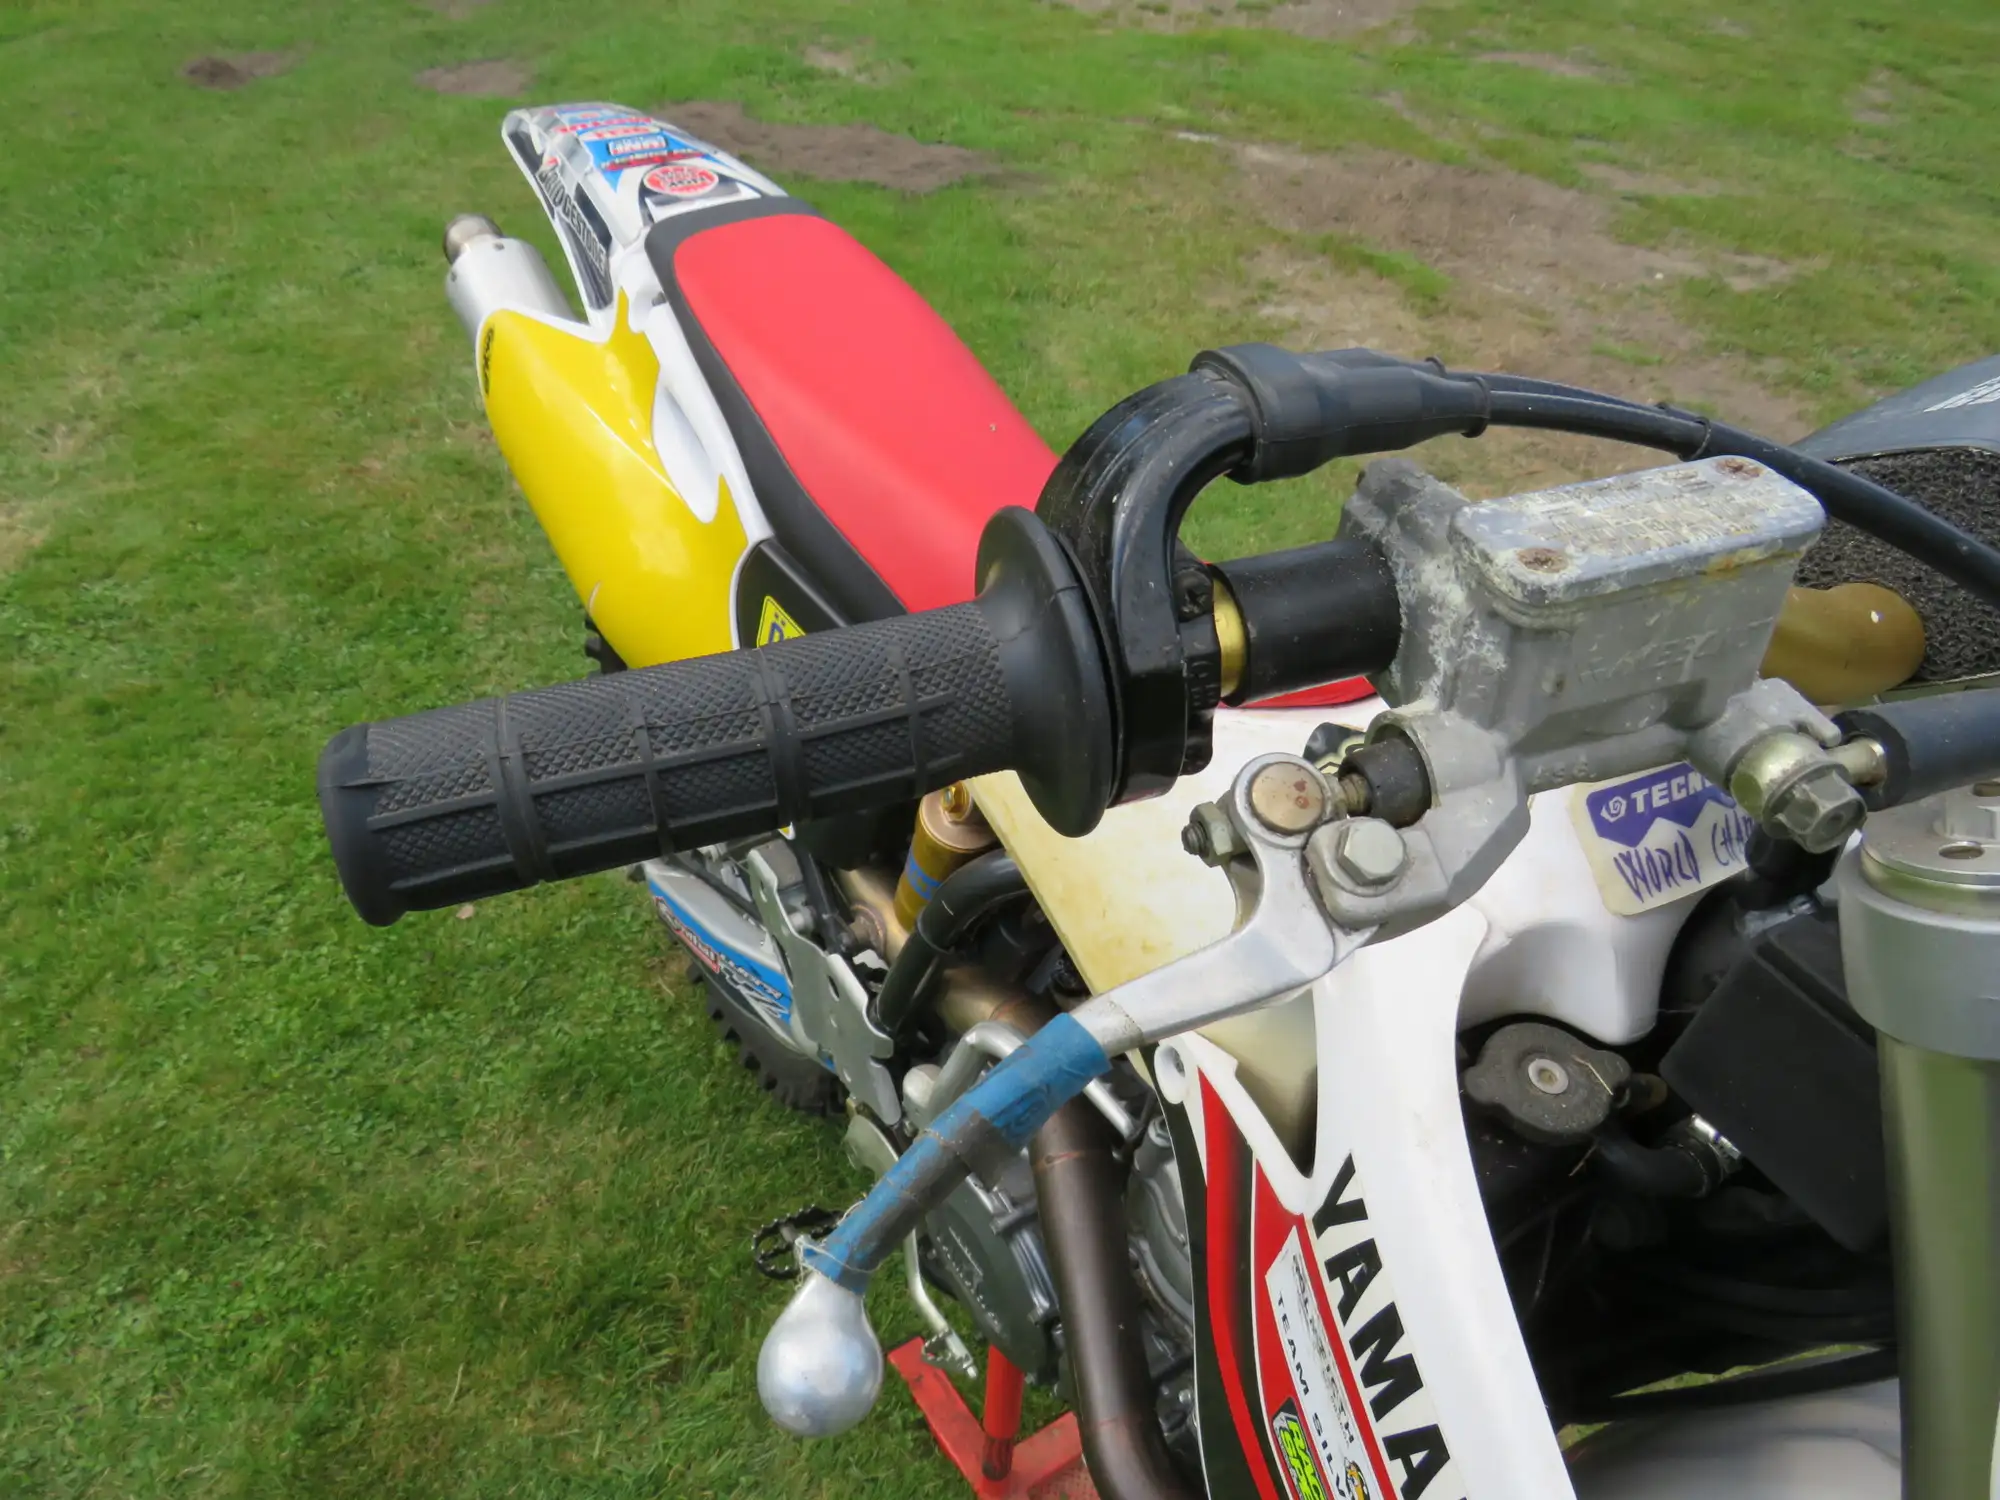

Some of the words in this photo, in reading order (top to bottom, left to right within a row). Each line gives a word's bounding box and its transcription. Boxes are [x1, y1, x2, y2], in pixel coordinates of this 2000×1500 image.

[535, 166, 609, 277] BRIDGESTONE
[1613, 829, 1702, 903] WORLD
[1277, 1290, 1310, 1396] TEAM
[1312, 1151, 1467, 1500] YAMA
